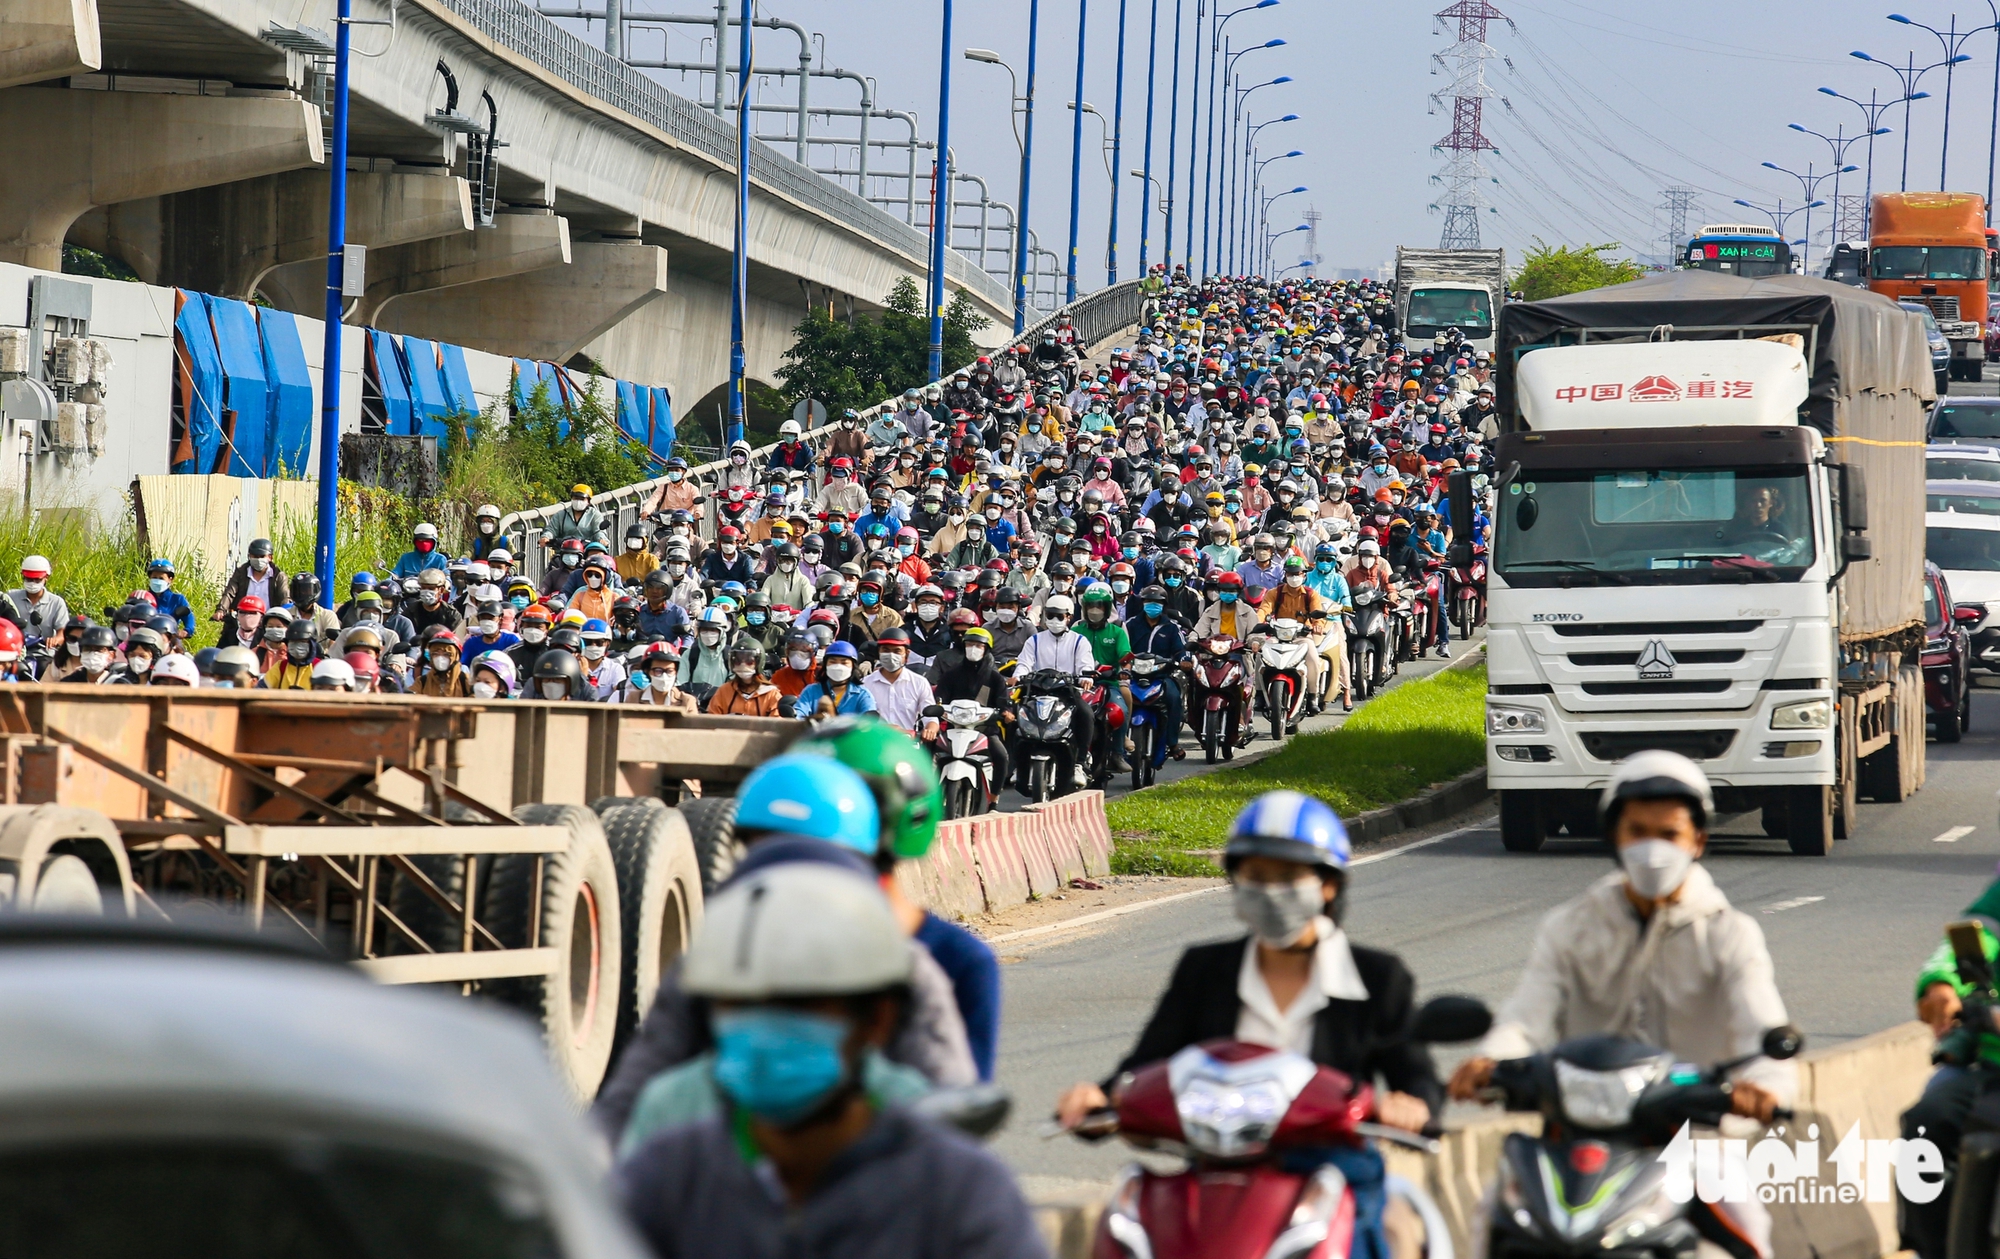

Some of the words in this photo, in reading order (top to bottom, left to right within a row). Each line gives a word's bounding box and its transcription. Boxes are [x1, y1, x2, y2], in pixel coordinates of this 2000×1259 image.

[1720, 247, 1747, 256] XANH
[1556, 383, 1623, 403] 中国
[1686, 380, 1754, 399] 重汽
[1532, 613, 1584, 622] HOWO
